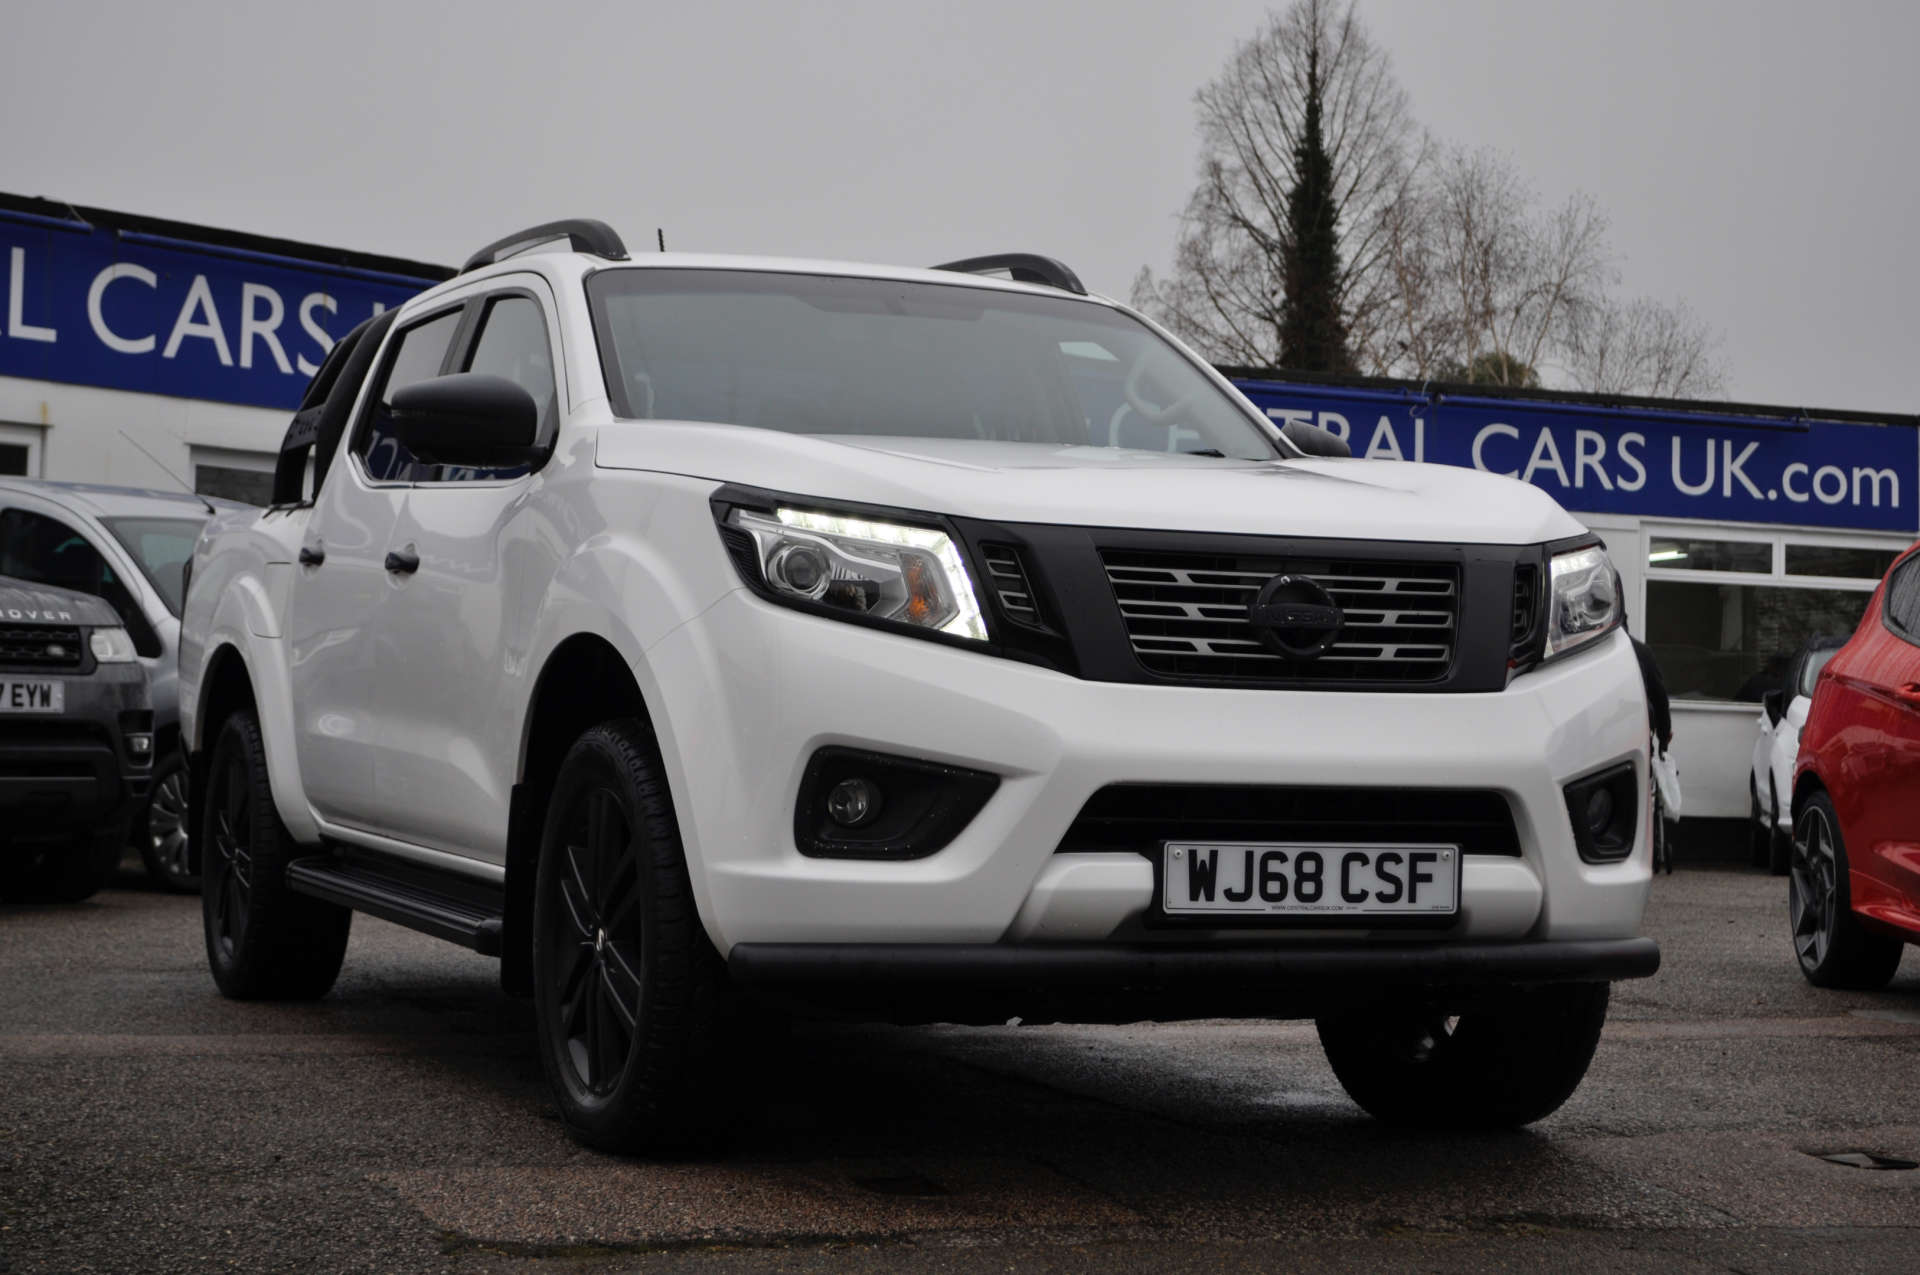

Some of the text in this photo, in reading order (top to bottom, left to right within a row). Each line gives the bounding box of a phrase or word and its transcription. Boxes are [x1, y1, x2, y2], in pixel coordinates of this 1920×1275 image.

[0, 246, 338, 380] L CARS
[1471, 423, 1647, 491] CARS
[1671, 435, 1900, 508] UK.com
[0, 609, 71, 621] OVER
[11, 684, 52, 708] EYW
[1187, 848, 1437, 904] WJ68 CSF
